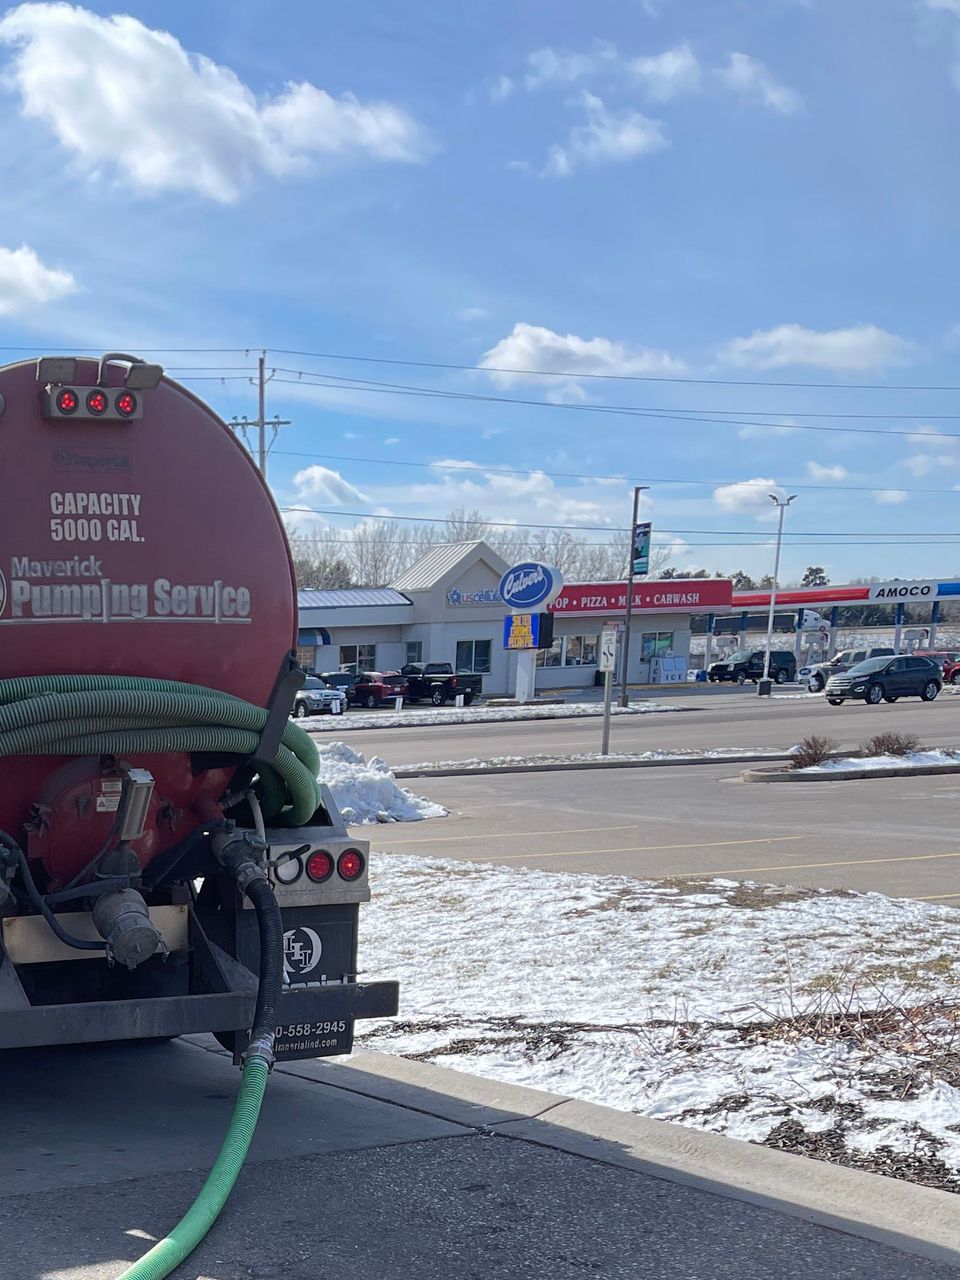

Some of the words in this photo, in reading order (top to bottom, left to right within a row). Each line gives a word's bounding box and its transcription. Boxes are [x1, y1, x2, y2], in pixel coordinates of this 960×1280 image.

[50, 492, 141, 516] CAPACITY
[50, 518, 102, 542] 5000
[106, 519, 145, 542] GAL.
[10, 555, 103, 578] Maverick
[503, 565, 545, 600] Culver's
[876, 586, 931, 598] AMOCO
[10, 578, 148, 624] Pumping
[153, 578, 251, 624] Service
[549, 597, 569, 609] POP
[581, 596, 608, 608] PIZZA
[618, 595, 642, 607] MLK
[653, 593, 700, 605] CARWASH
[665, 673, 683, 681] ICE
